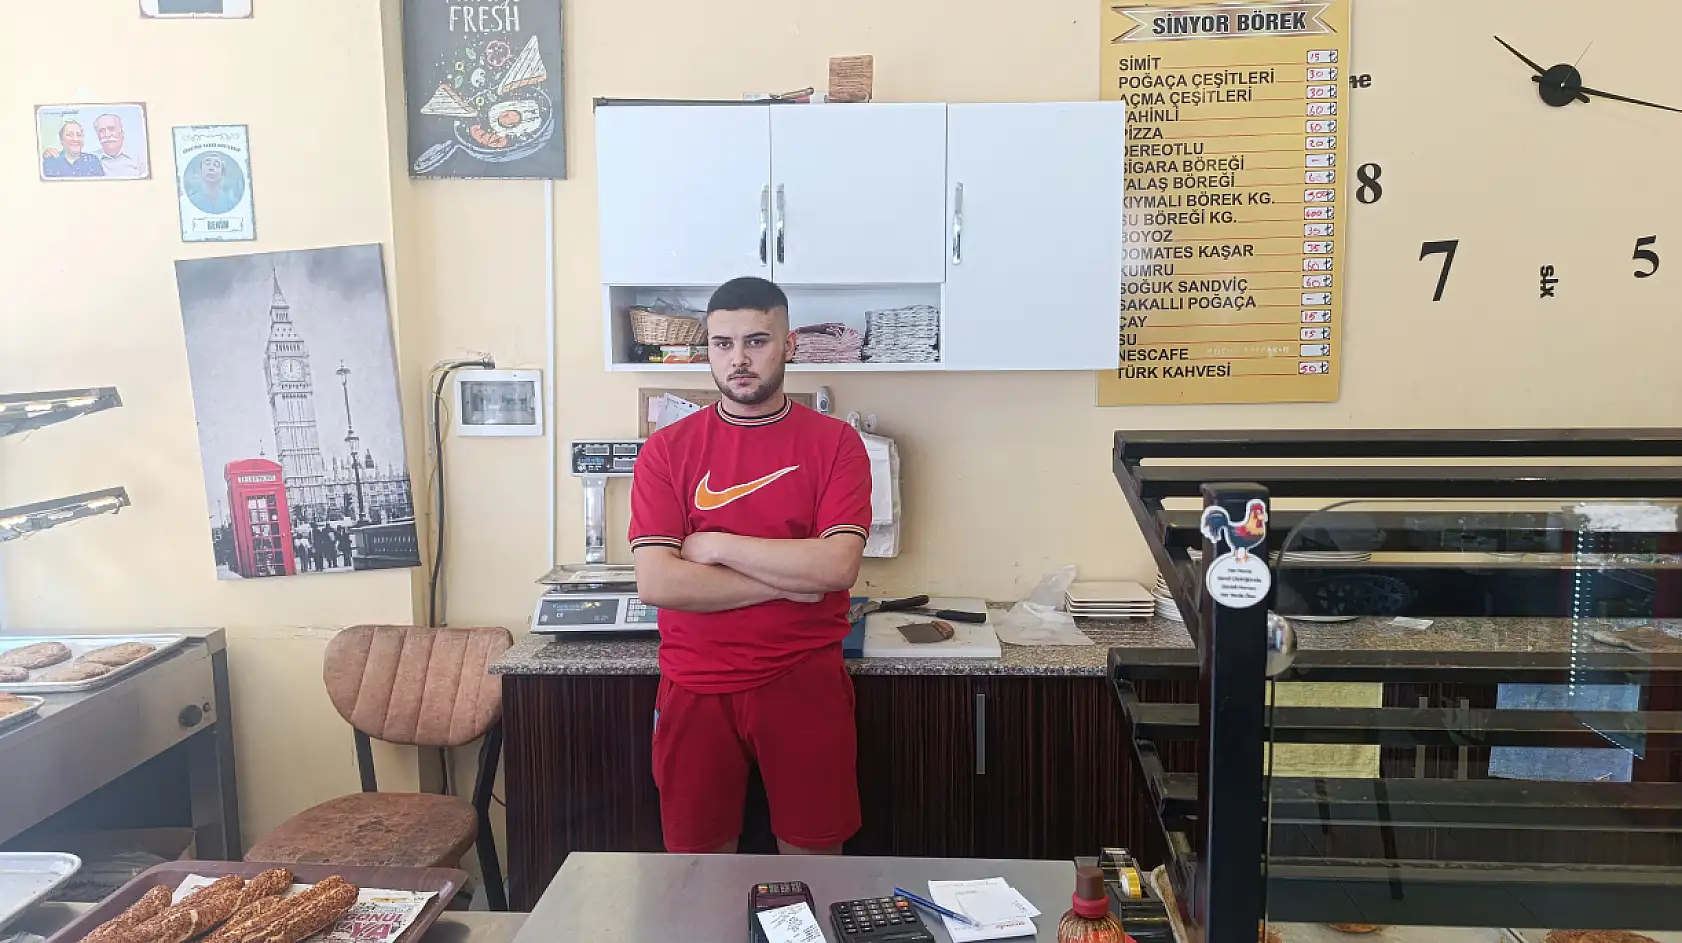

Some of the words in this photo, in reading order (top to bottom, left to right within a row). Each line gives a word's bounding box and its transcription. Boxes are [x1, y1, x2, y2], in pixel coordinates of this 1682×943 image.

[449, 5, 520, 32] FRESH
[1152, 13, 1229, 34] SİNYOR
[1237, 9, 1306, 31] BÖREK
[1118, 55, 1161, 71] SİMİT
[1310, 53, 1320, 61] 15
[1118, 73, 1188, 90] POĞAÇA
[1191, 68, 1275, 89] ÇEŞİTLERİ
[1120, 93, 1166, 109] AÇMA
[1169, 86, 1252, 107] ÇEŞİTLERİ
[1125, 106, 1179, 123] AHİNLİ
[1124, 125, 1164, 140] İZZA
[1182, 155, 1244, 173] BÖREĞİ
[1124, 177, 1169, 193] ALAŞ
[1173, 172, 1236, 189] BÖREĞİ
[1356, 162, 1382, 204] 8
[1186, 191, 1243, 207] BÖREK
[1248, 192, 1275, 205] KG.
[1143, 208, 1205, 226] BÖREĞİ
[1209, 211, 1237, 224] KG.
[1198, 243, 1255, 260] KAŞAR
[1633, 234, 1660, 279] 5
[1419, 239, 1459, 302] 7
[1178, 276, 1248, 294] SANDVİÇ
[1540, 265, 1559, 299] six
[1187, 294, 1257, 311] POĞAÇA
[1305, 311, 1317, 320] 15
[1118, 333, 1137, 346] SU
[1118, 348, 1189, 361] NESCAFE
[1117, 364, 1159, 379] TÜRK
[1162, 362, 1231, 379] KAHVESİ
